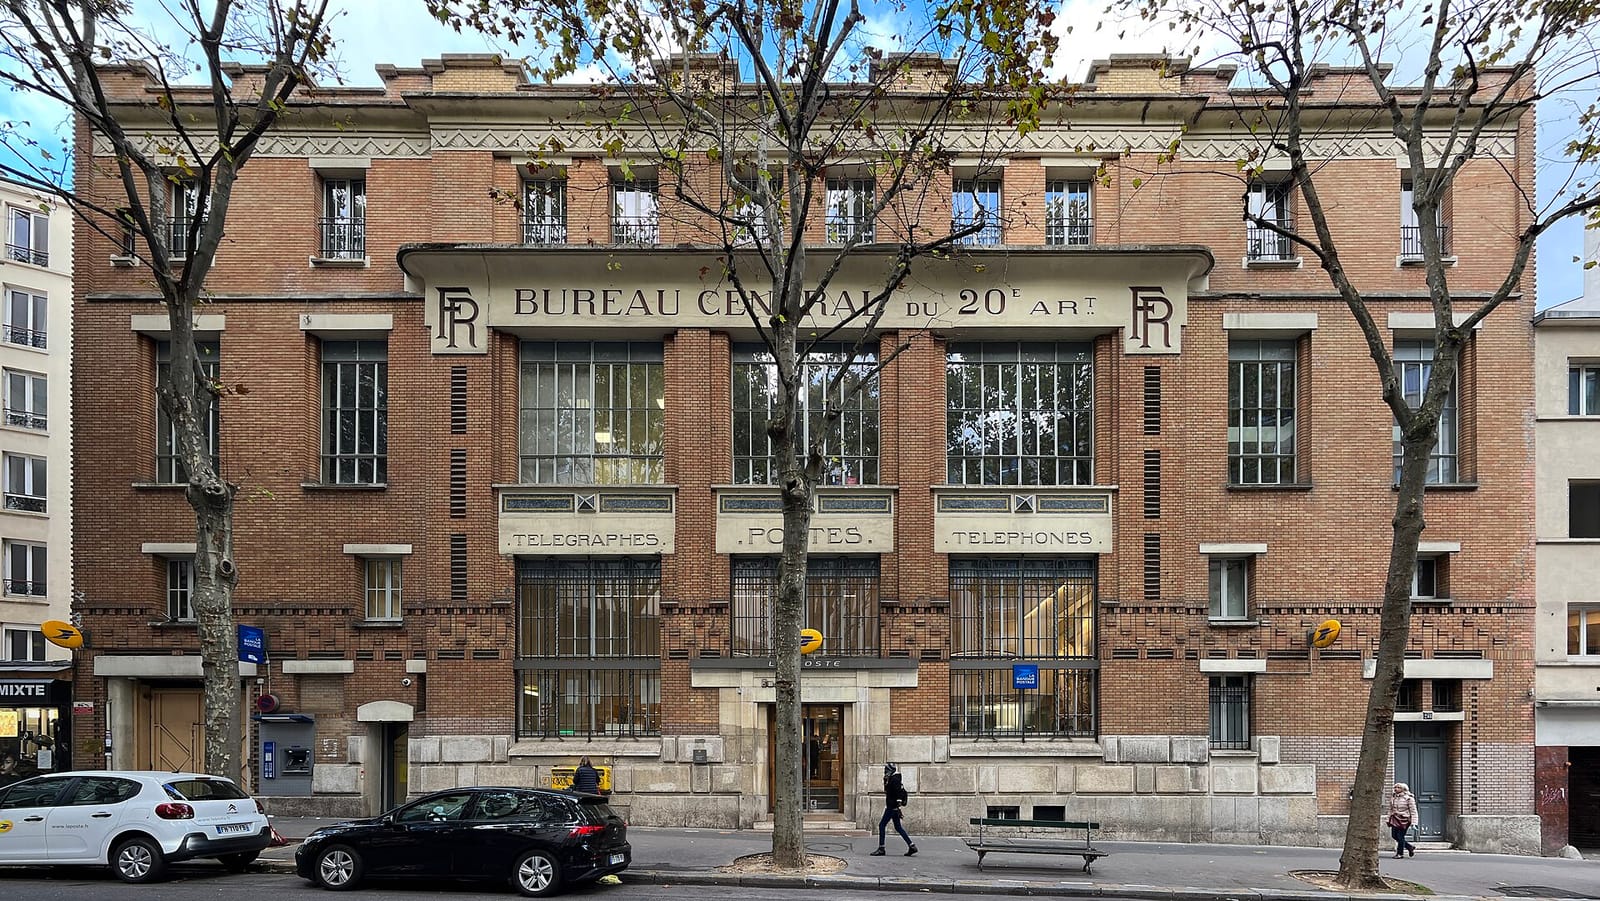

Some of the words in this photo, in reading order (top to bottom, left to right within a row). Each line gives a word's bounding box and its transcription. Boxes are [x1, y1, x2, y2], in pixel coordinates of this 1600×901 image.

[513, 288, 681, 316] BUREAU
[697, 289, 881, 316] CENRAL
[906, 302, 938, 317] DU
